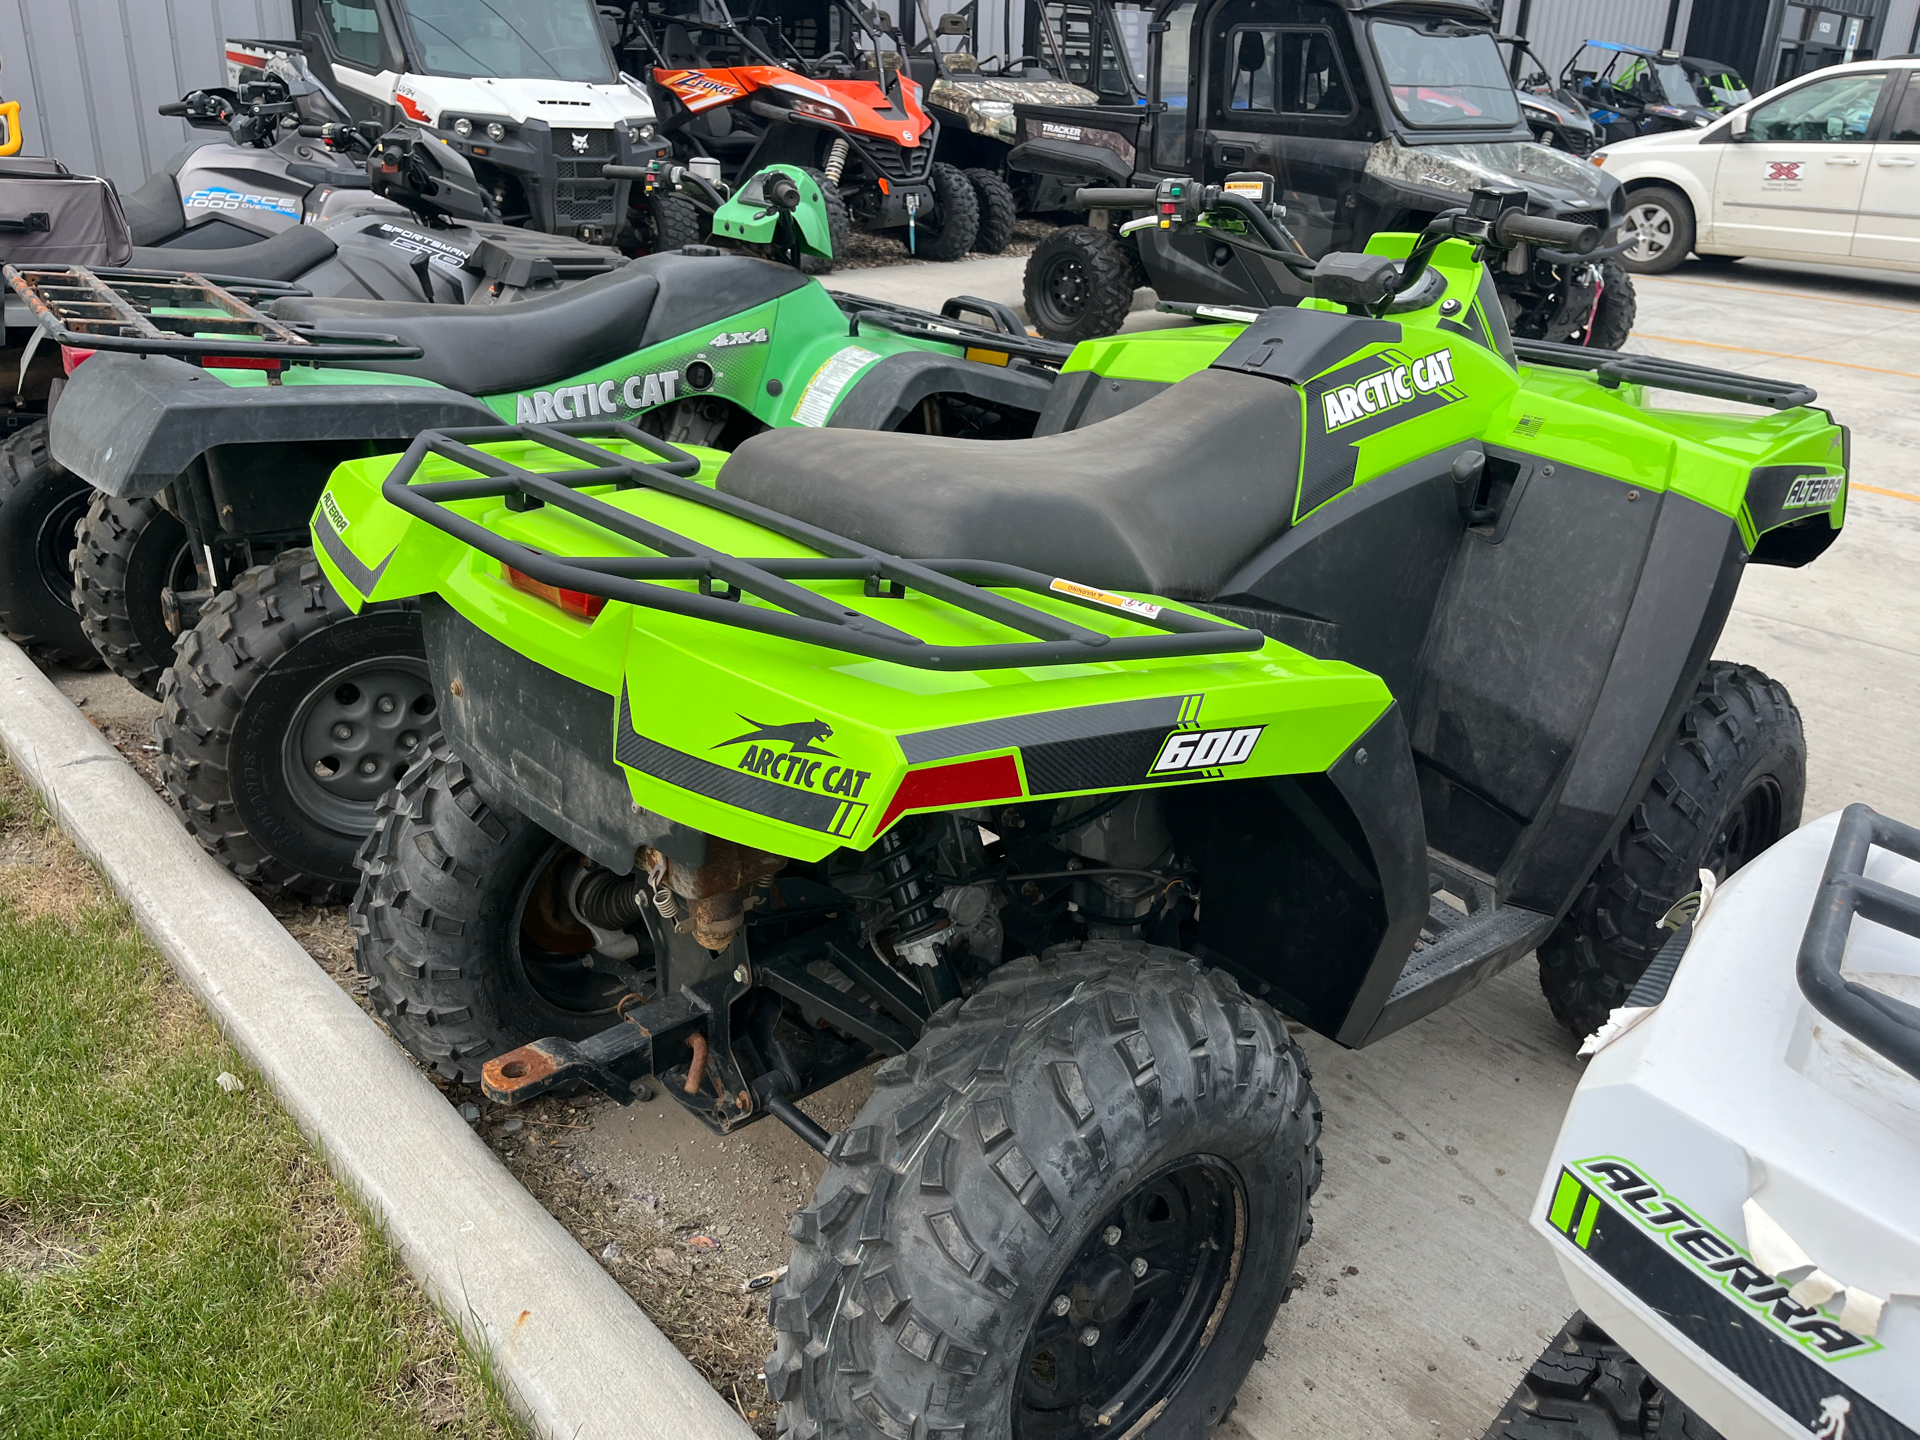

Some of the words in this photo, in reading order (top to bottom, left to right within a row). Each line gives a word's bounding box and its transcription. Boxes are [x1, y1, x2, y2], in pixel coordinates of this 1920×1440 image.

[1042, 123, 1081, 137] TRACKER
[186, 199, 239, 209] 1000
[241, 203, 296, 213] OVERLAND
[190, 190, 296, 207] CFORCE
[380, 223, 471, 259] SPORTSMAN
[516, 380, 617, 425] ARCTIC
[623, 370, 679, 409] CAT
[1324, 364, 1413, 429] ARCTIC
[1411, 349, 1455, 392] CAT
[1785, 477, 1843, 505] ALTERRA
[323, 492, 348, 532] ALTERRA
[1067, 585, 1097, 598] WARNING
[1153, 727, 1262, 771] 600
[738, 744, 822, 789] ARCTIC
[822, 765, 872, 799] CAT
[1585, 1162, 1866, 1354] ALTERRA
